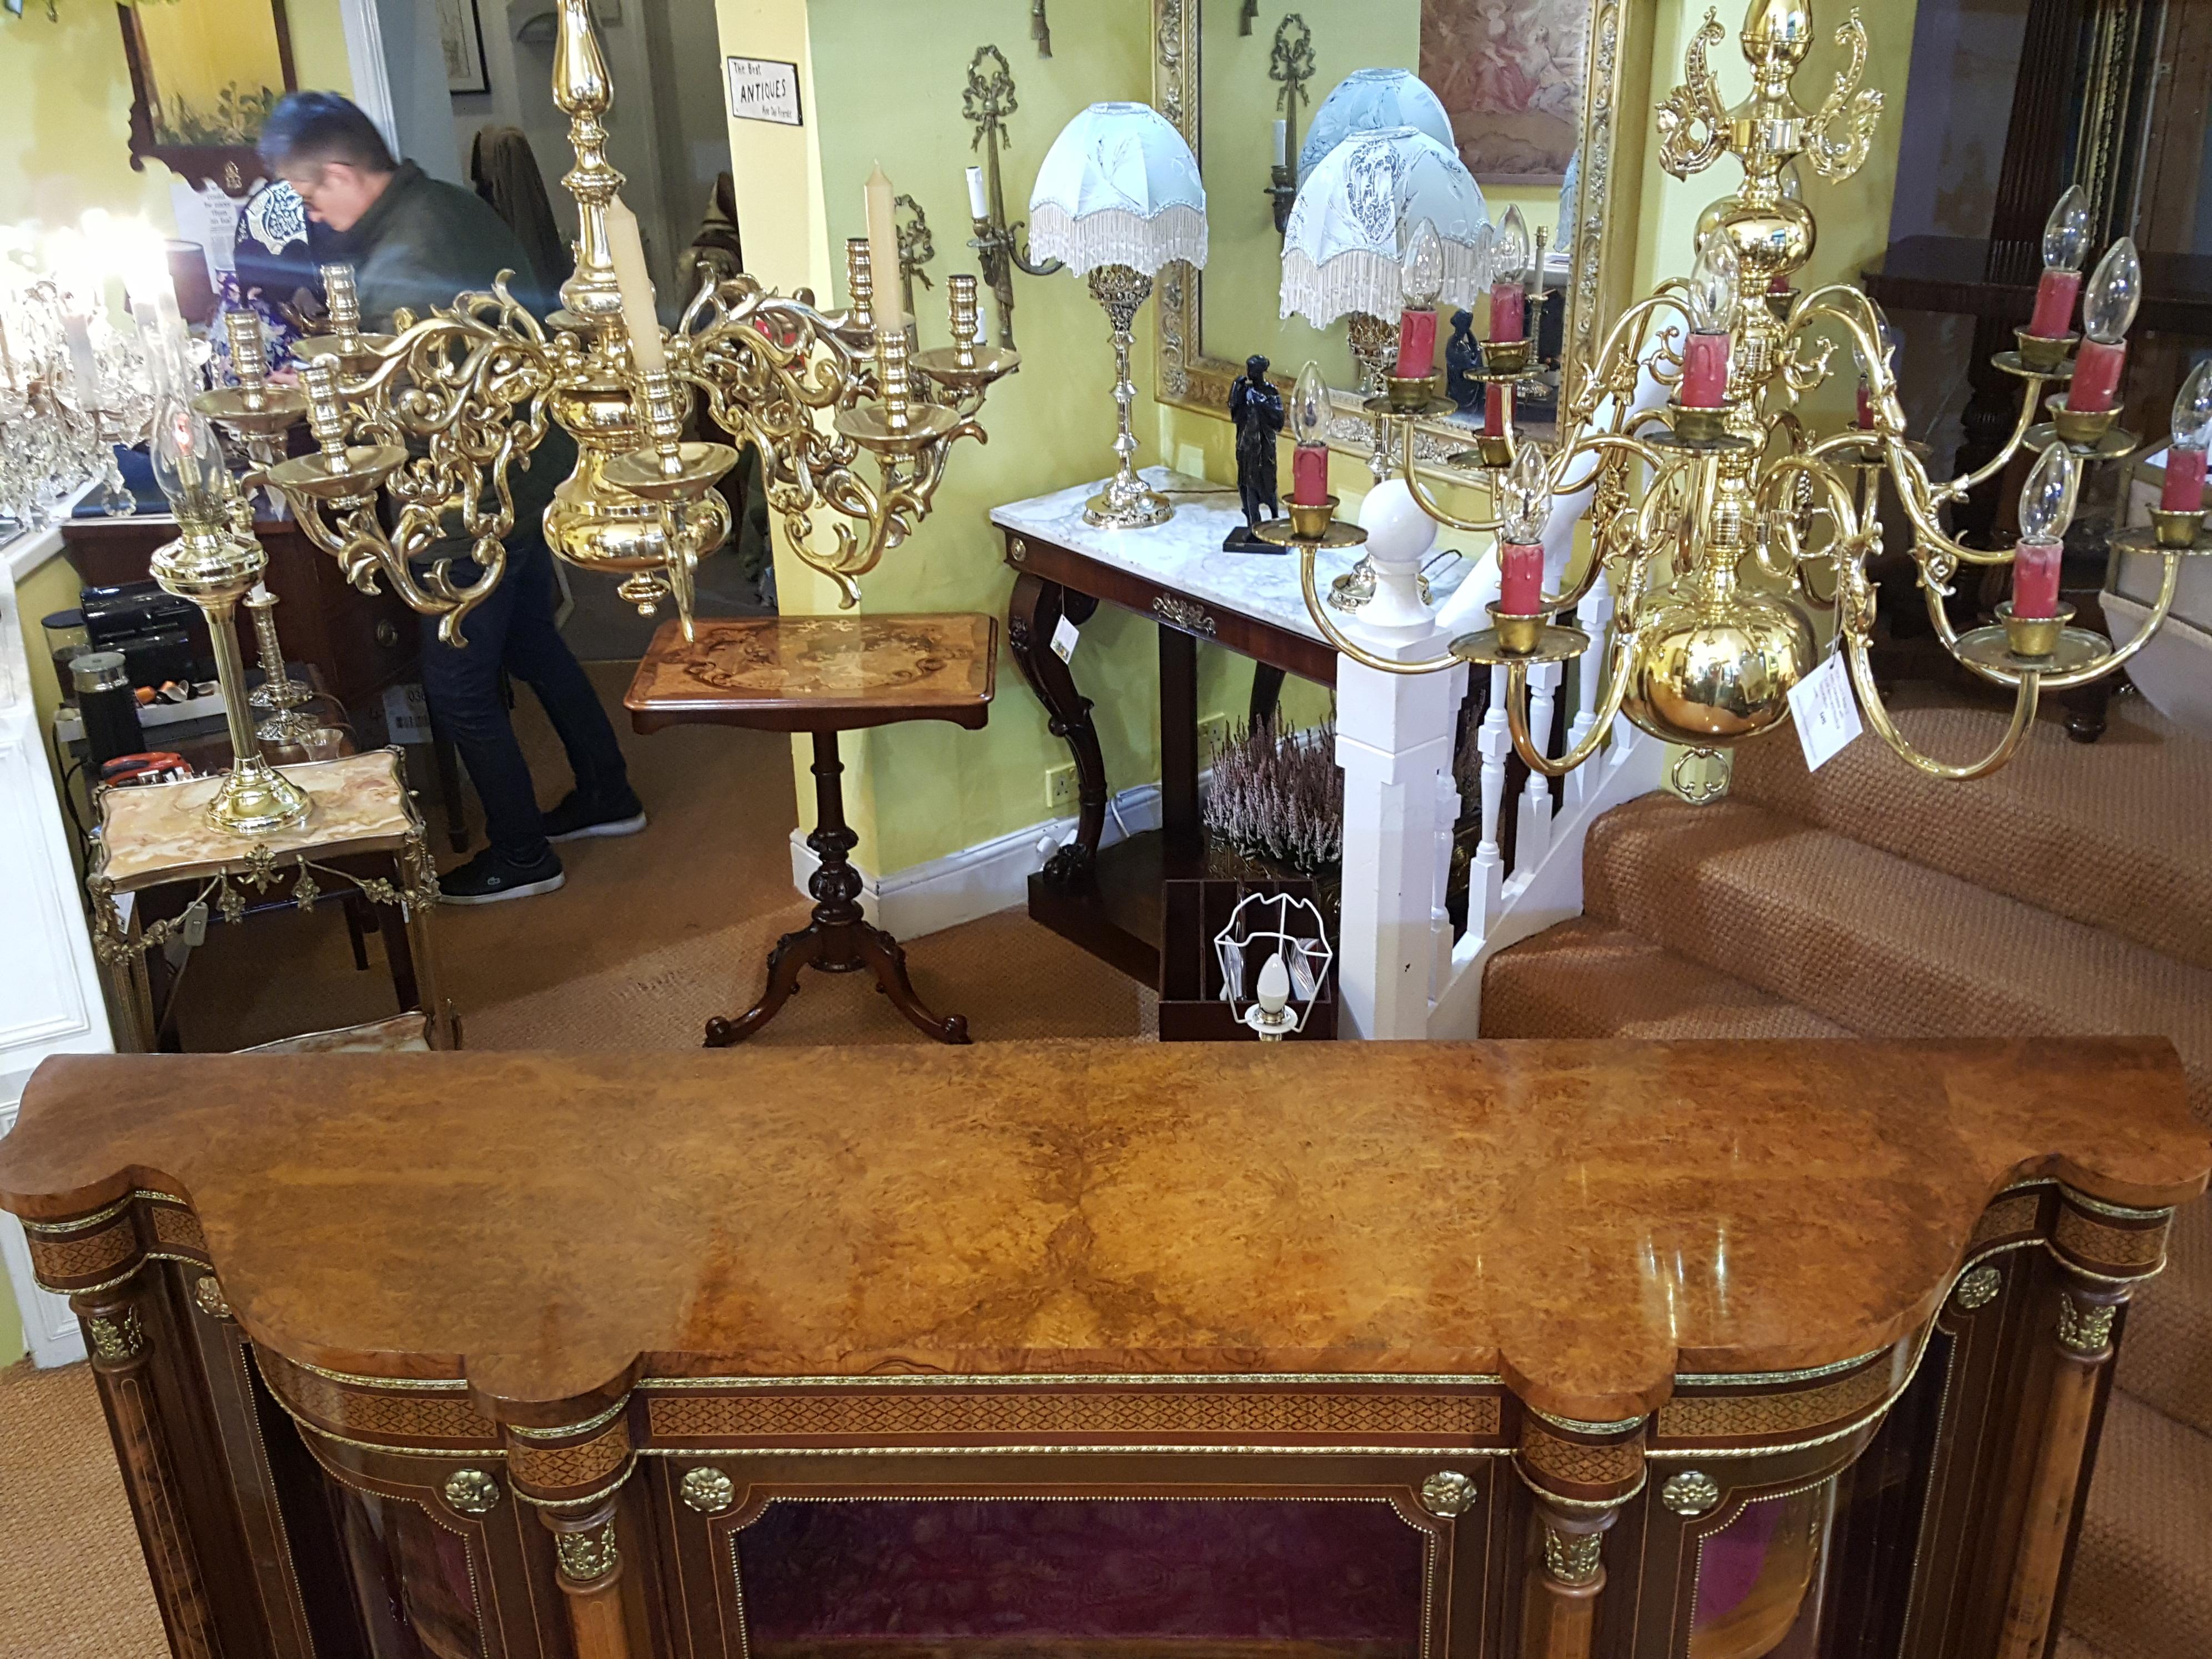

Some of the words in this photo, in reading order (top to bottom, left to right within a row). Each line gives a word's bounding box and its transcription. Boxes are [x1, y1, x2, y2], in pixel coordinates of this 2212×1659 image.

[733, 62, 745, 75] The
[748, 62, 761, 76] Best
[741, 79, 786, 103] ANTIQUES
